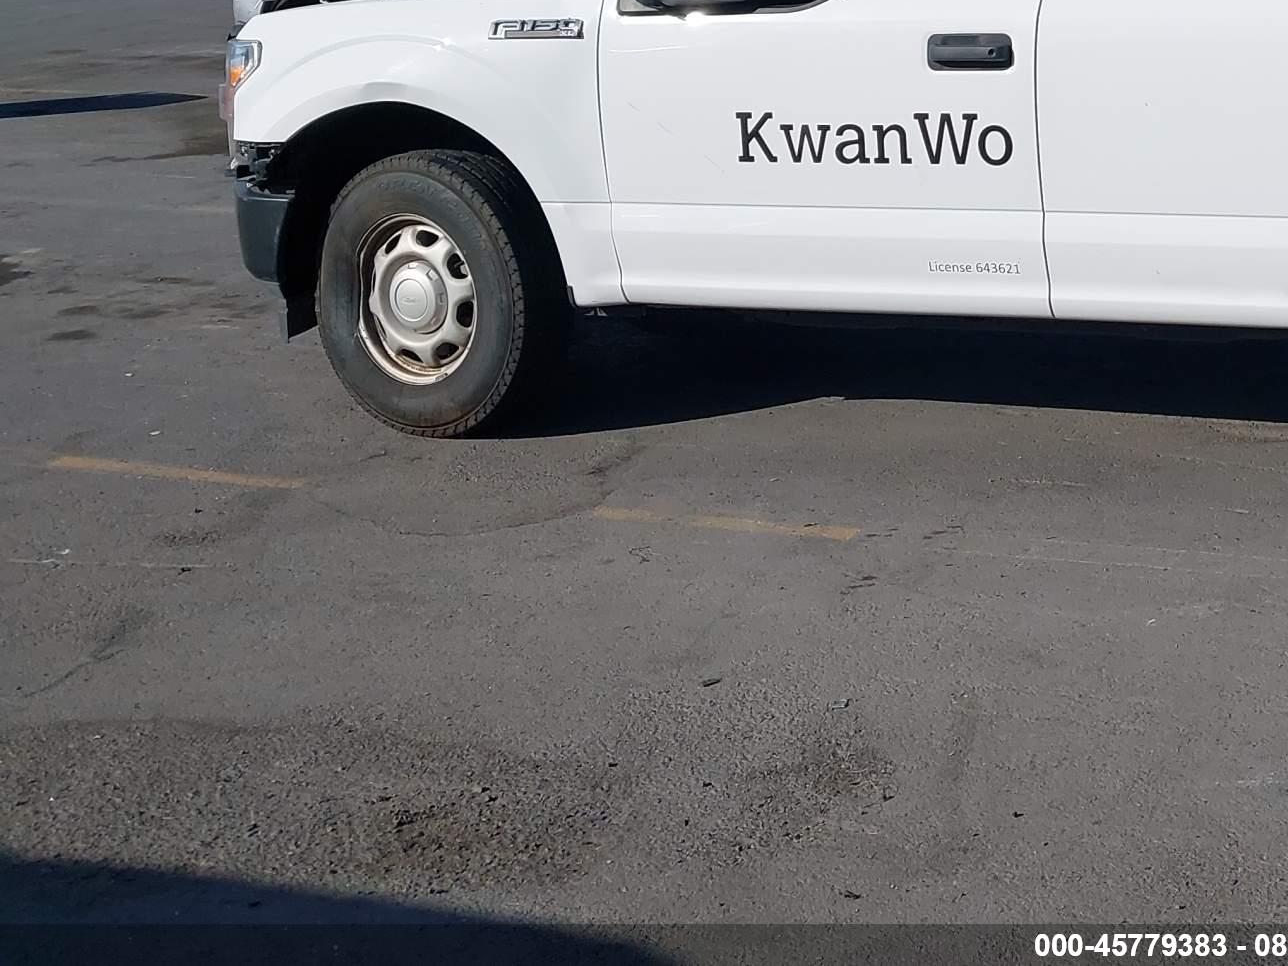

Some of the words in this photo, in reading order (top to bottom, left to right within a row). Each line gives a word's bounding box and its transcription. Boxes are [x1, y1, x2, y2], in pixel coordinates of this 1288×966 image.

[735, 111, 1014, 166] KwanWo
[928, 260, 972, 273] License
[975, 262, 1021, 275] 643621
